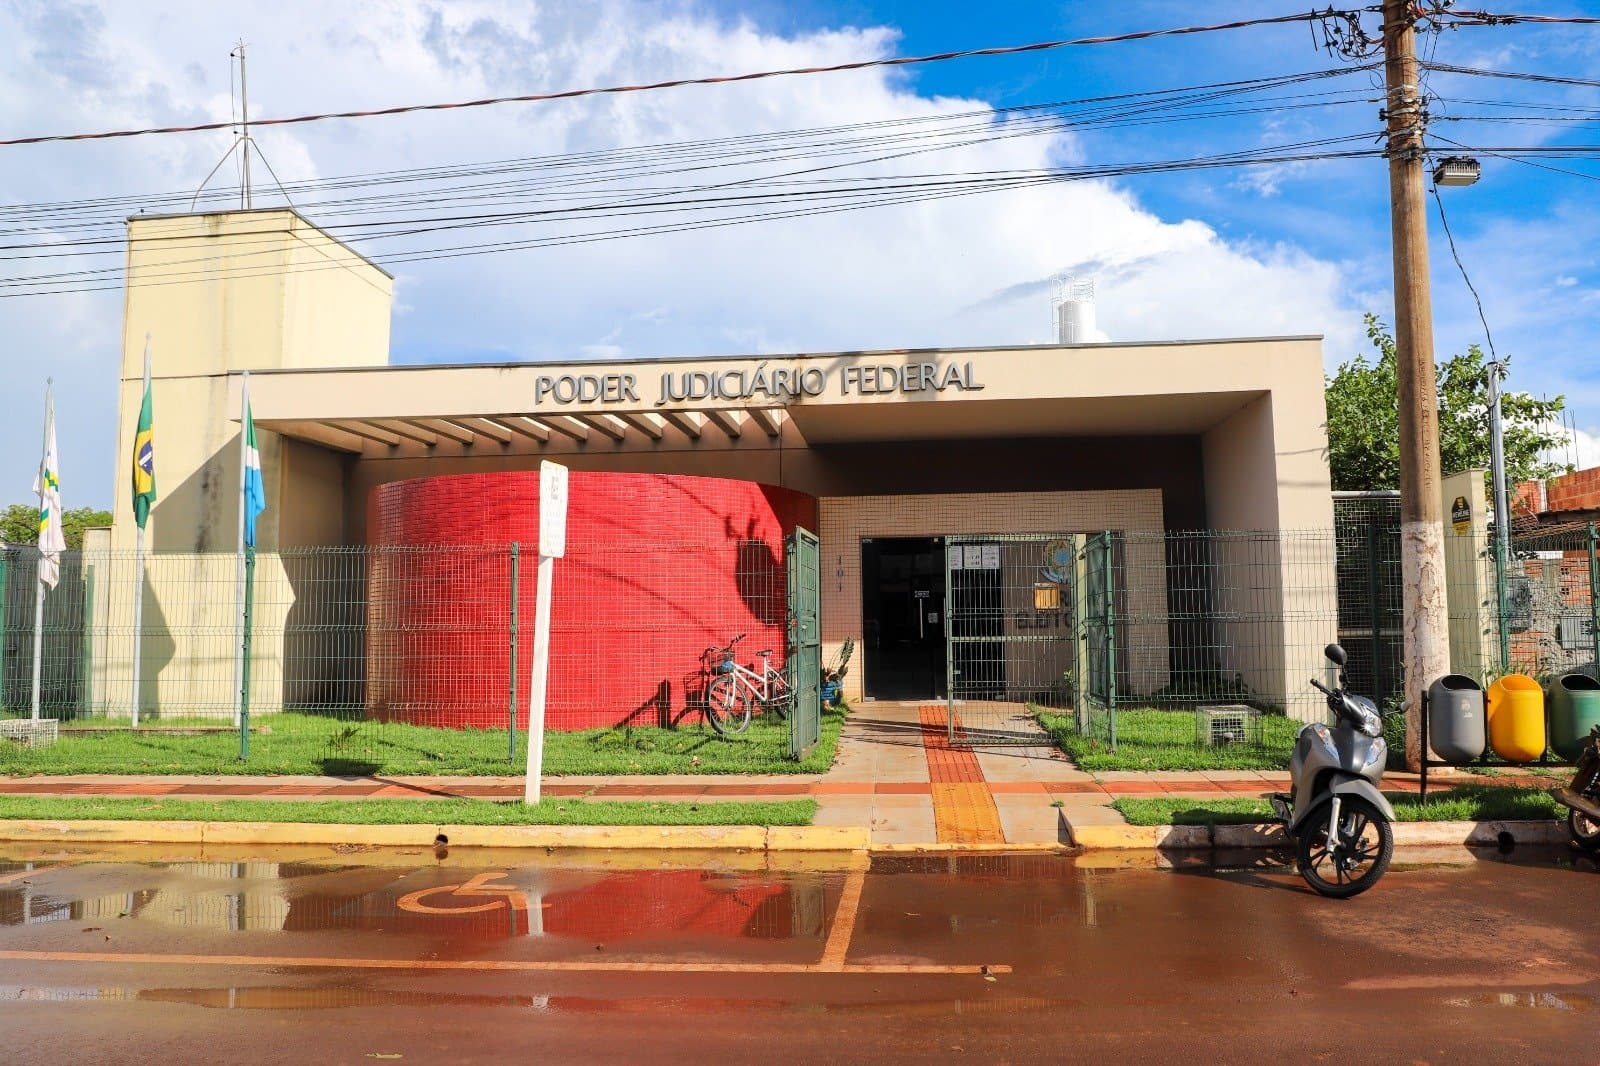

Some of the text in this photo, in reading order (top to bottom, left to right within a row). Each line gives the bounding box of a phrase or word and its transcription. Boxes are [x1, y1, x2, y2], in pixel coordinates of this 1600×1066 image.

[535, 361, 986, 406] PODER JUDICIÁRIO FEDERAL
